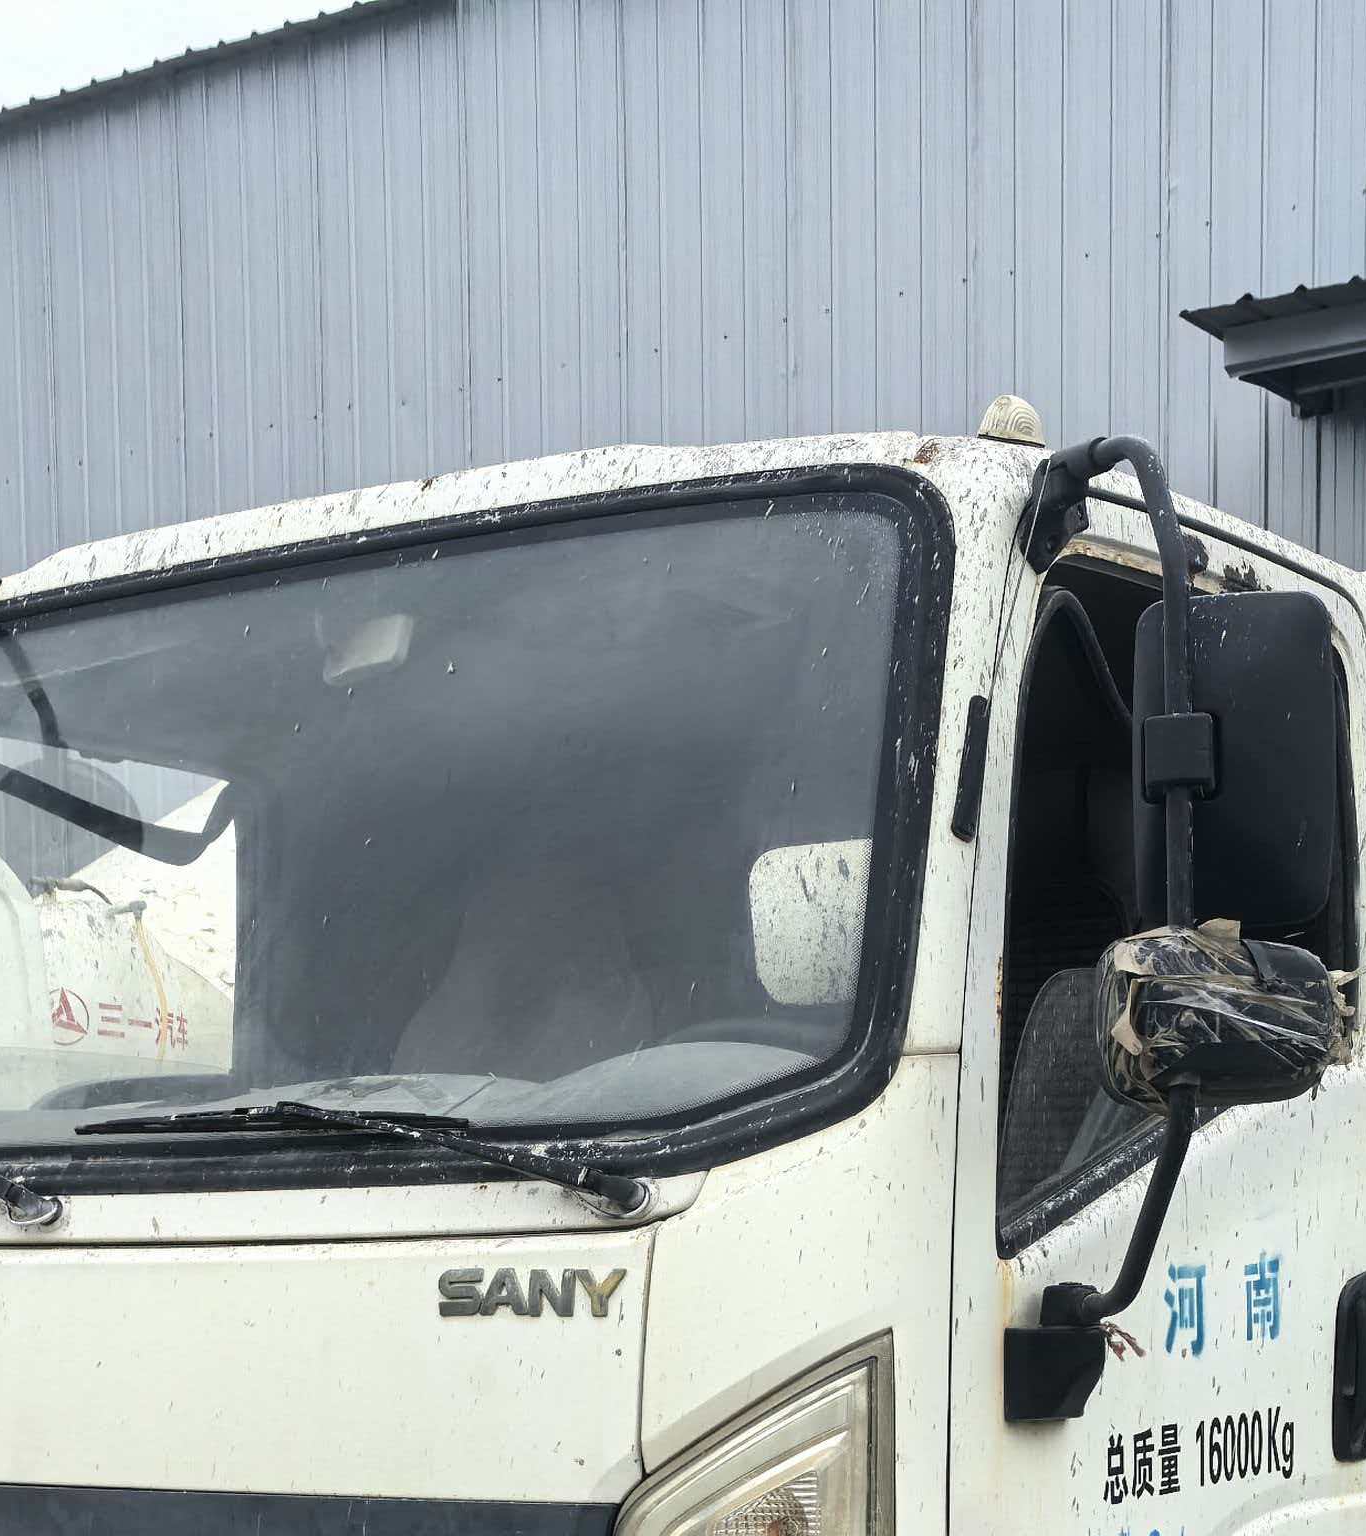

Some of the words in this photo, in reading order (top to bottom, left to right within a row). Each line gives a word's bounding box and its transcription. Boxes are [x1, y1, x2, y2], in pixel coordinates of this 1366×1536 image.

[438, 1267, 627, 1318] SANY
[1163, 1251, 1281, 1357] 河南
[1102, 1423, 1182, 1505] 总质量
